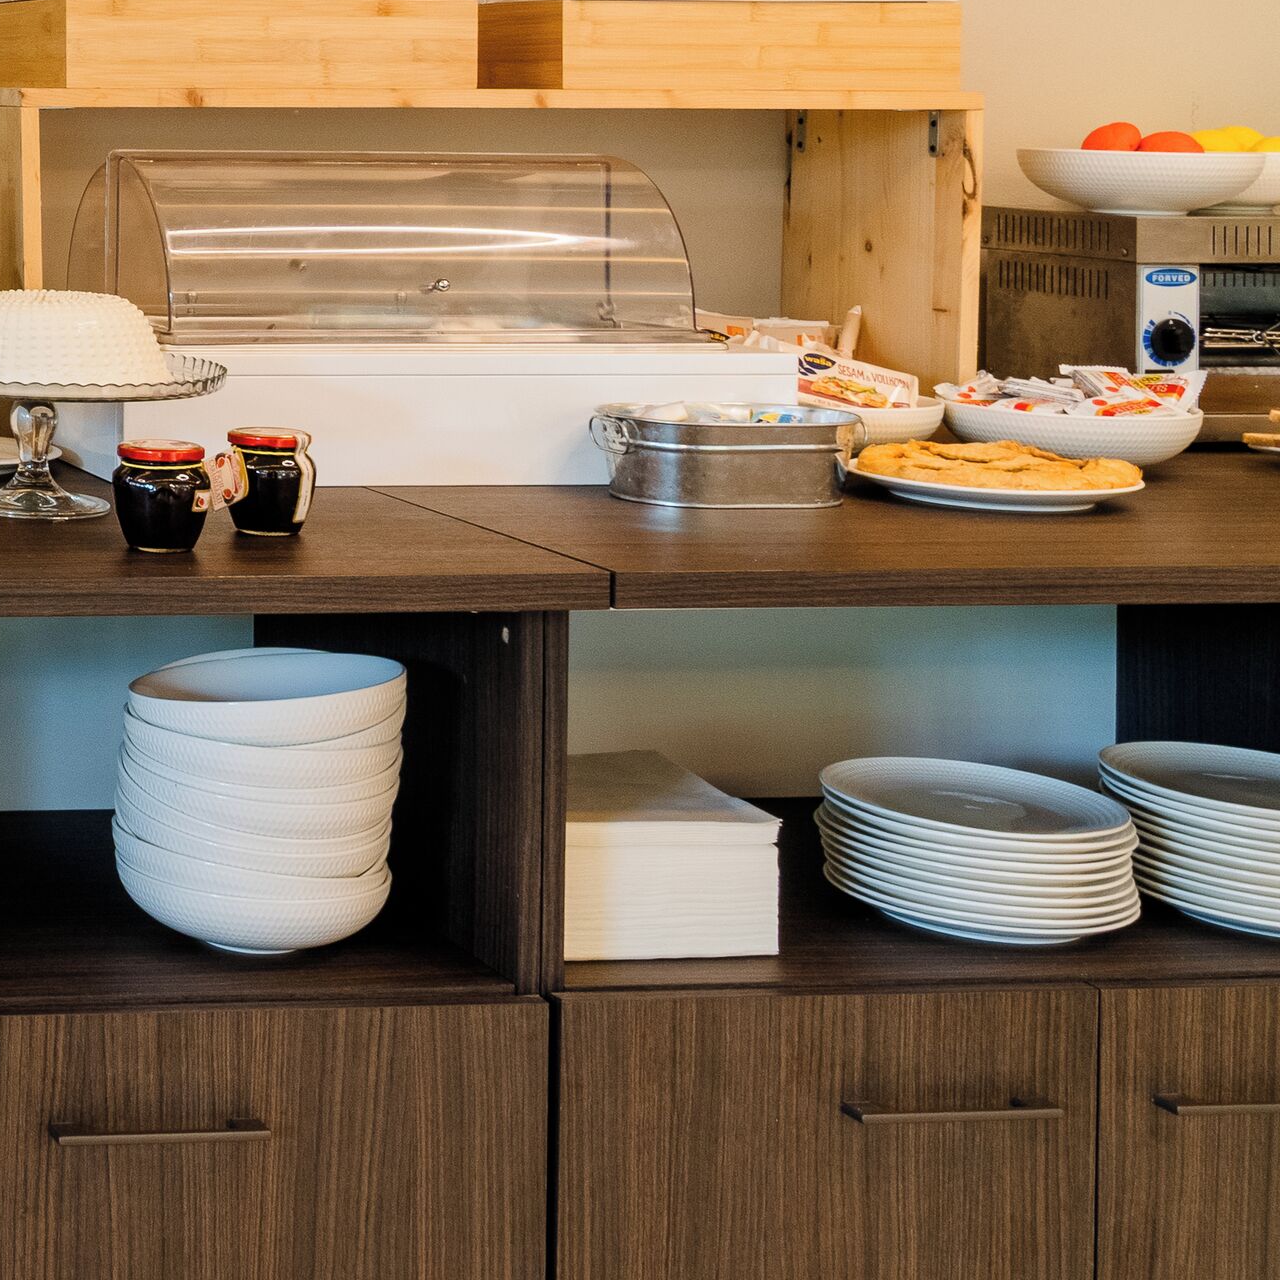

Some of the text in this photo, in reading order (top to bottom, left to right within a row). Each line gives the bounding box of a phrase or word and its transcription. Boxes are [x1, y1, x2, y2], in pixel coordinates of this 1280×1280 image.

[1151, 274, 1191, 282] FORVED
[837, 364, 865, 380] SESAM
[870, 372, 910, 390] VOLLKORN
